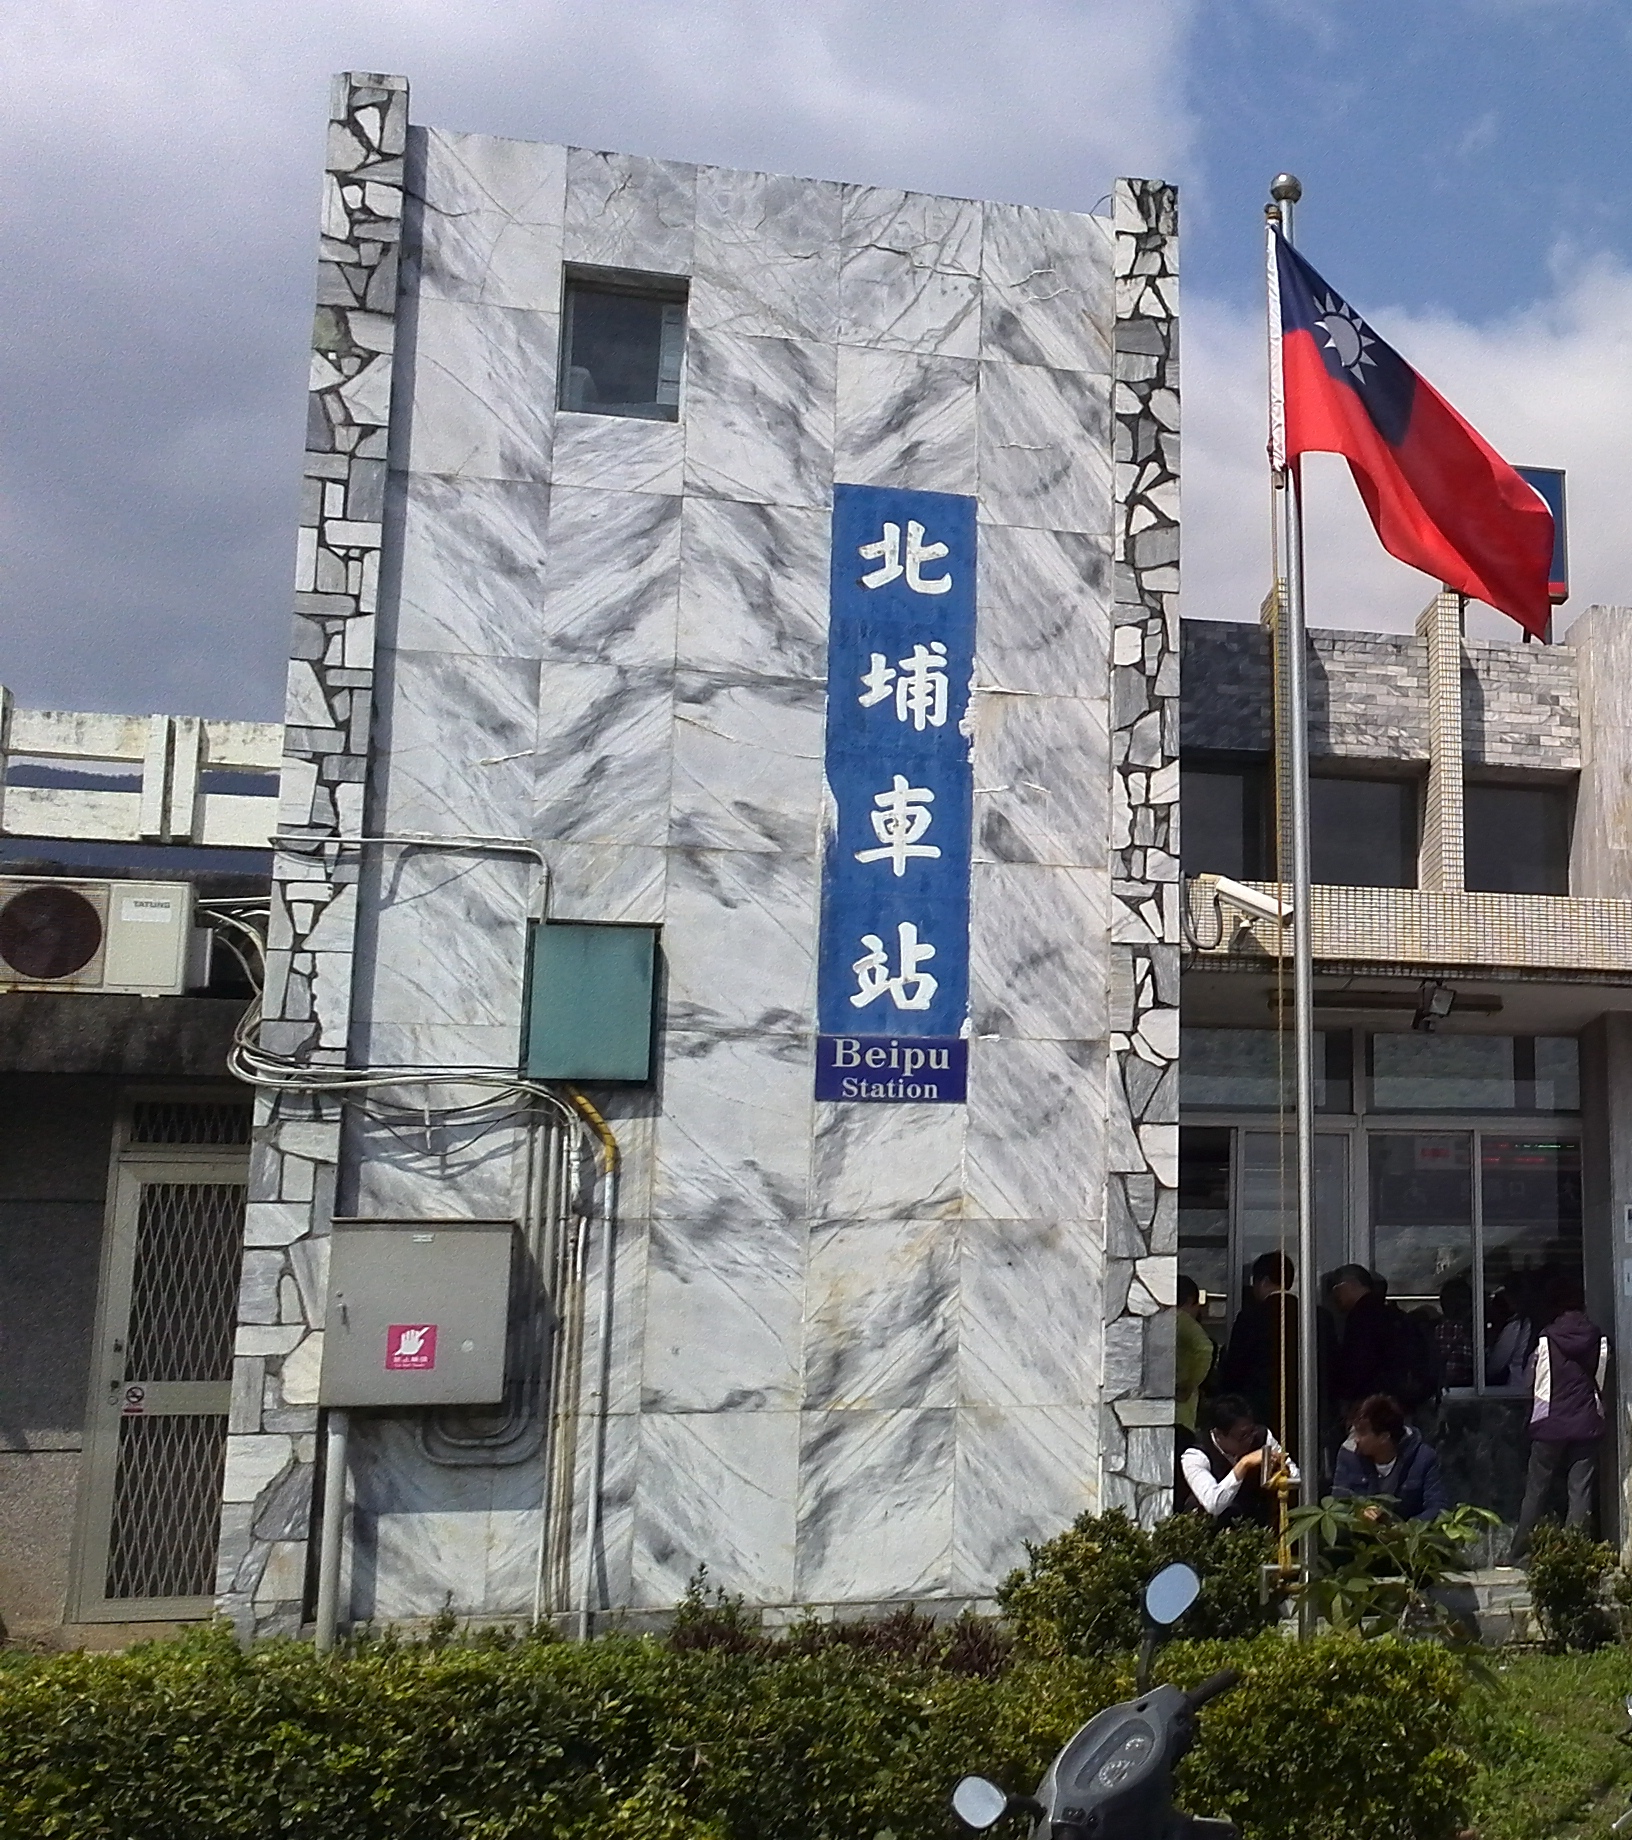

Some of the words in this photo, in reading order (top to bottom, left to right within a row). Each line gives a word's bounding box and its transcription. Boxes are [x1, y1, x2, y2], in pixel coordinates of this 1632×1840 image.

[849, 520, 952, 1011] 北埔車站
[832, 1038, 950, 1077] Beipu
[842, 1077, 938, 1099] Station
